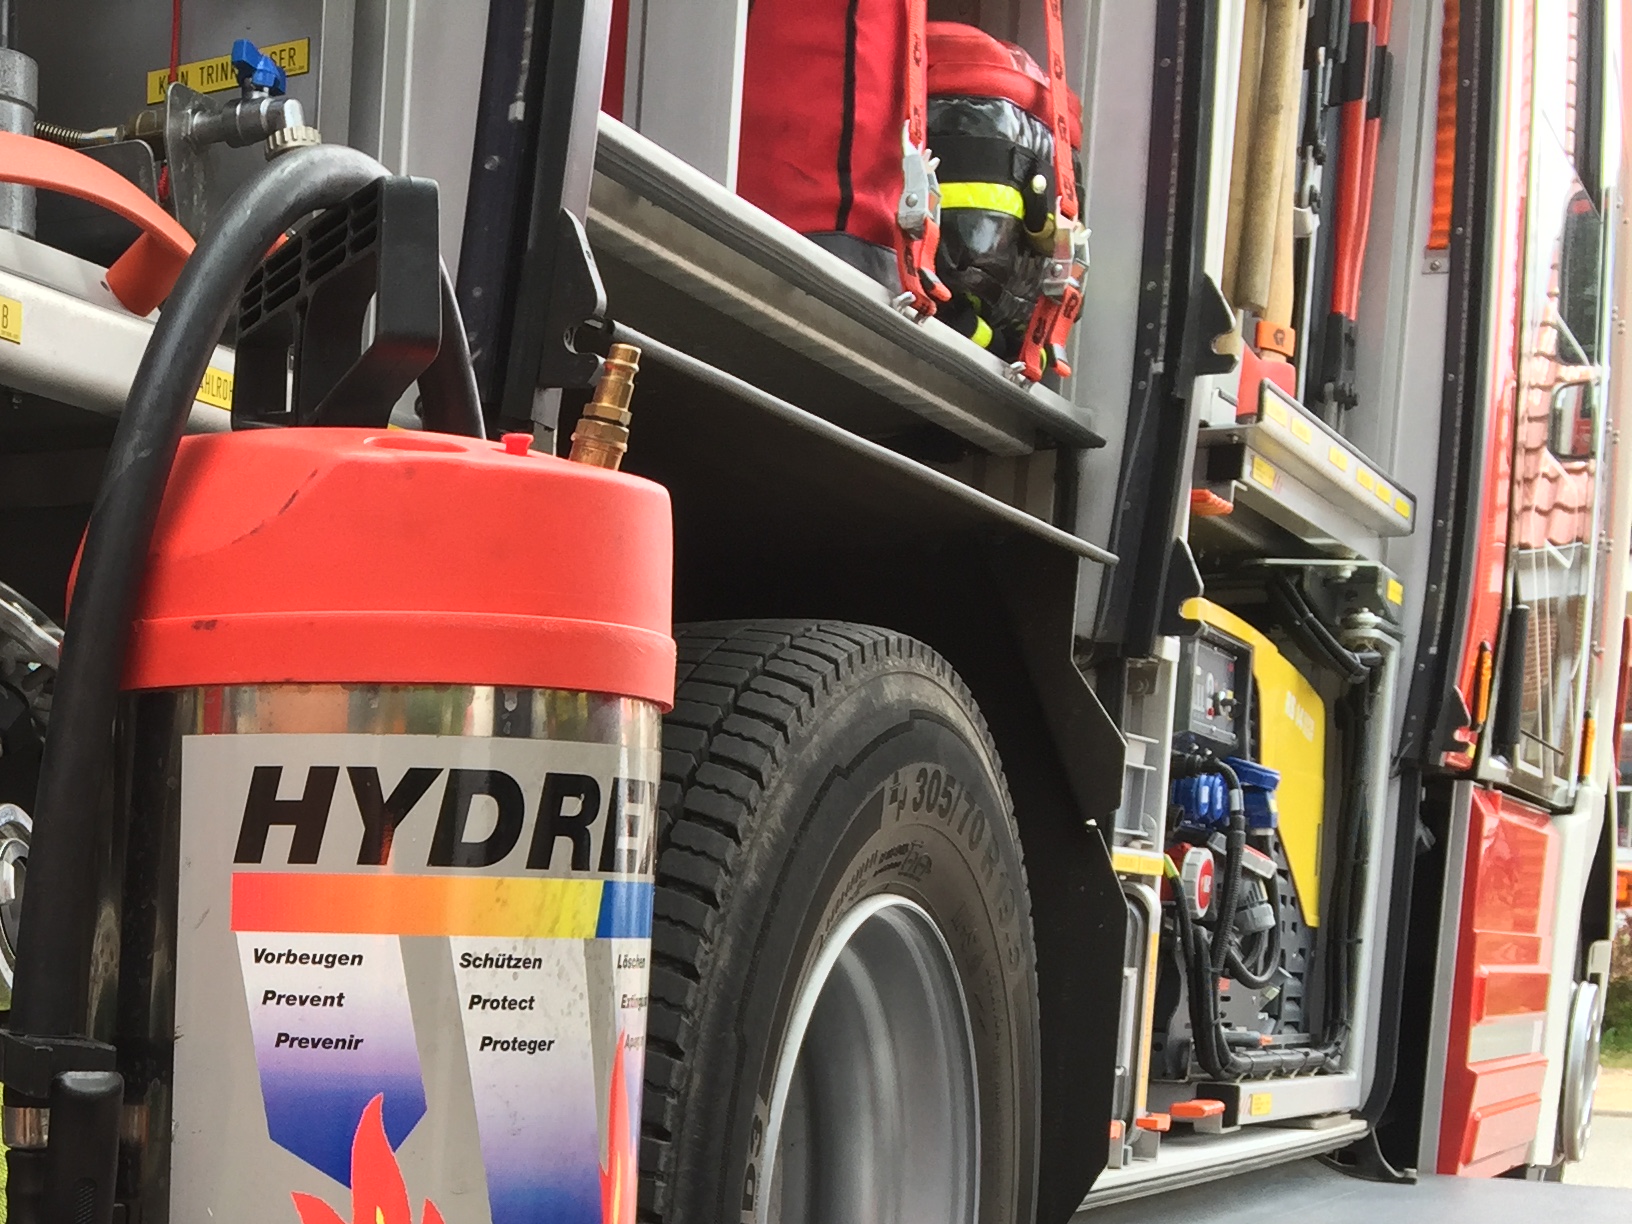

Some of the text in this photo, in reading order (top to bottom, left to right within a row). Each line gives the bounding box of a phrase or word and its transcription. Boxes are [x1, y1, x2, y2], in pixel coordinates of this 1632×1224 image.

[158, 70, 189, 95] KN
[1, 304, 9, 329] B
[252, 947, 364, 971] Vorbeugen
[459, 951, 543, 971] Schützen
[261, 989, 346, 1009] Prevent
[468, 993, 536, 1012] Protect
[274, 1032, 364, 1051] Prevenir
[479, 1035, 555, 1055] Proteger
